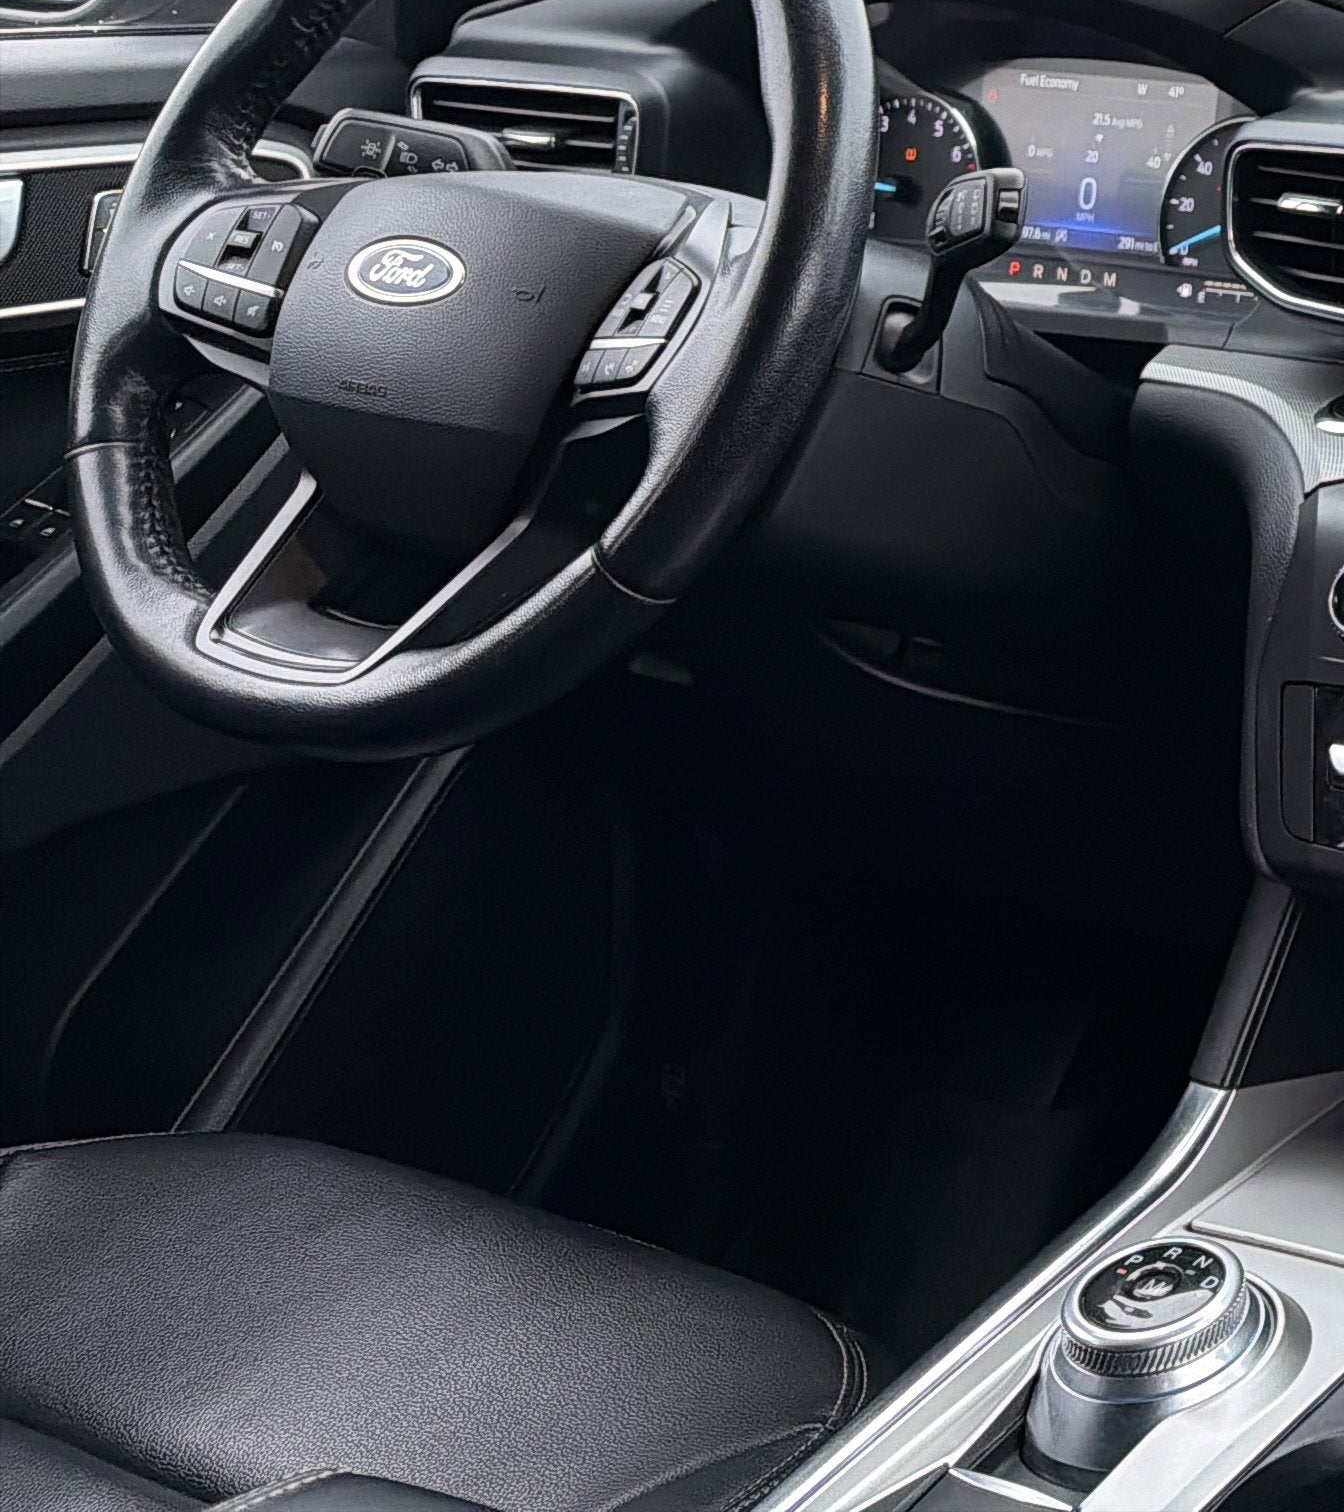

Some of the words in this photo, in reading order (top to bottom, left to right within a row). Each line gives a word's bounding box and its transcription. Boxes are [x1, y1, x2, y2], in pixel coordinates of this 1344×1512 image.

[1020, 73, 1040, 88] Fuel
[1040, 74, 1080, 91] Economy
[1137, 83, 1148, 96] W
[880, 115, 890, 133] 3
[907, 109, 917, 126] 4
[931, 119, 945, 138] 5
[951, 145, 962, 163] 6
[1085, 150, 1099, 164] 20
[1147, 156, 1161, 169] 40
[1079, 176, 1098, 210] 0
[1178, 197, 1195, 212] 20
[1075, 212, 1095, 223] MPH
[1117, 236, 1135, 250] 291
[368, 251, 433, 288] Ford
[1008, 260, 1022, 275] P
[1032, 264, 1044, 280] R
[1056, 267, 1068, 282] N
[1080, 269, 1092, 284] D
[1104, 271, 1117, 287] M
[1124, 1254, 1144, 1266] P
[1162, 1246, 1183, 1260] R
[1192, 1255, 1214, 1269] N
[1199, 1275, 1219, 1288] D
